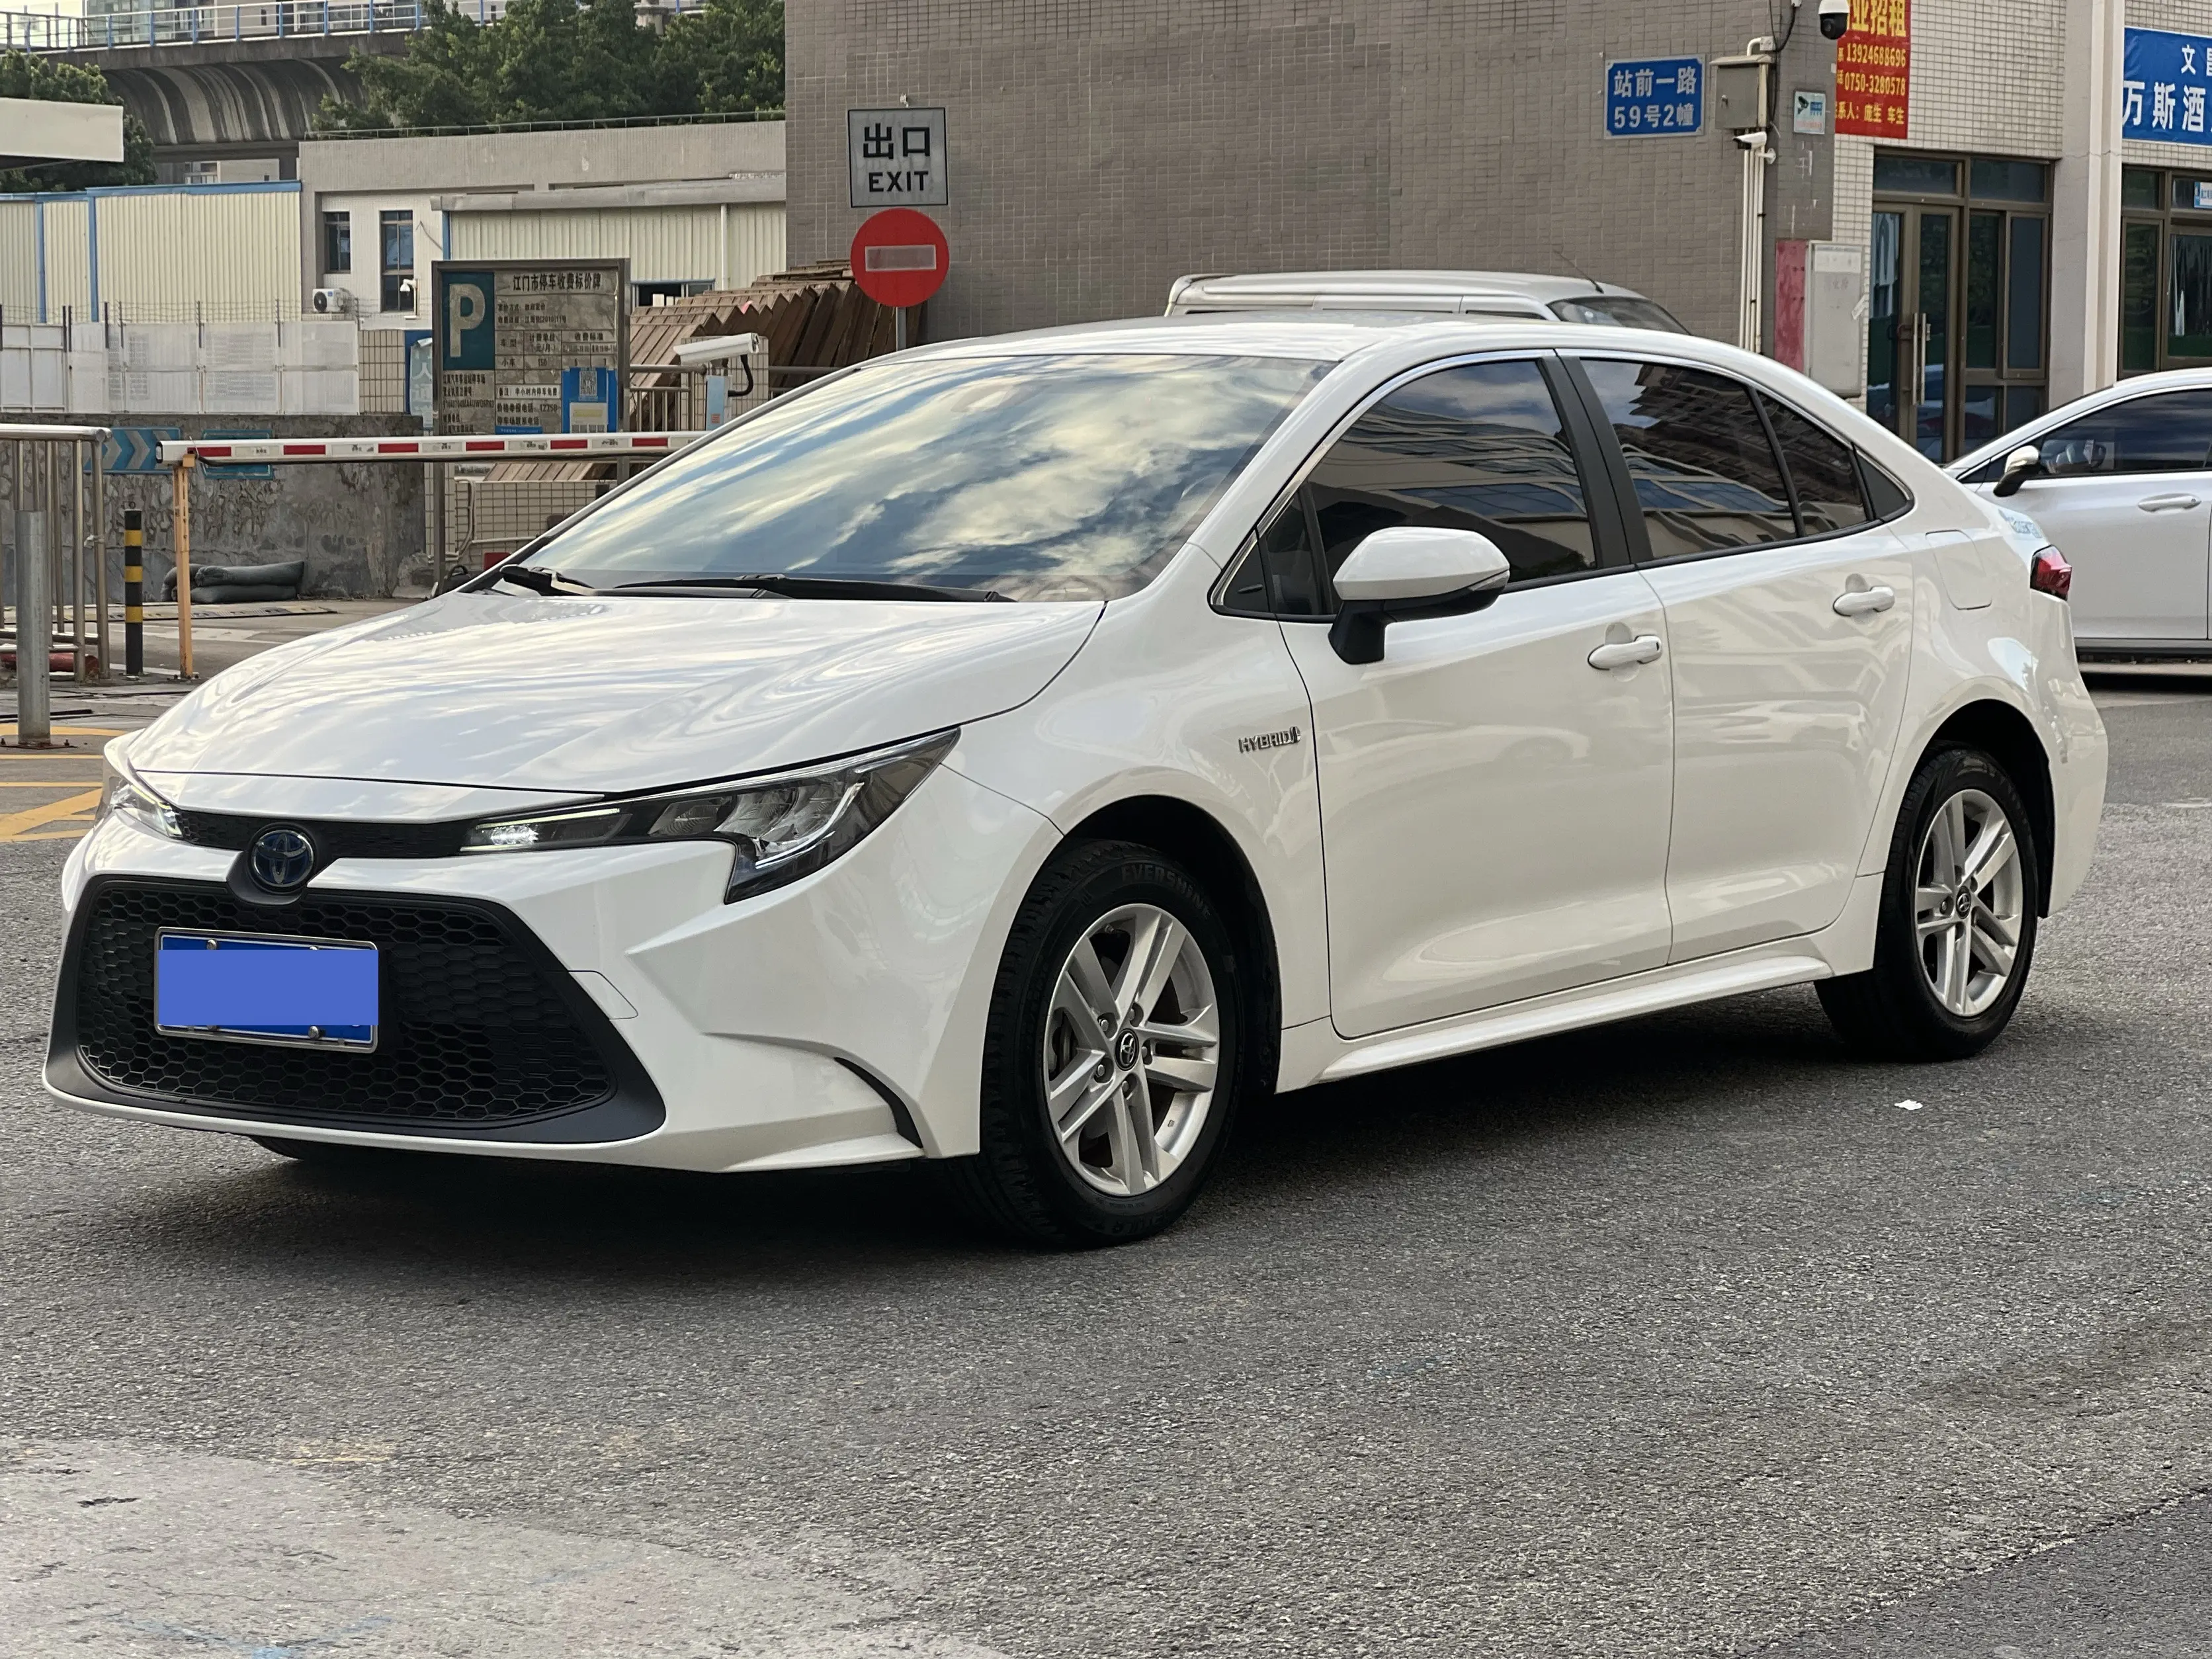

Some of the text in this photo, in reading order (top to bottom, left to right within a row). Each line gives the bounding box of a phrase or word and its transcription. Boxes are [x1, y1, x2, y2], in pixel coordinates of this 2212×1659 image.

[1848, 0, 1906, 37] 业招租
[1846, 42, 1906, 67] 13924688696
[1613, 66, 1697, 98] 站前一路
[1844, 72, 1906, 96] 0750-3280578
[1614, 103, 1694, 128] 59号2幢
[1835, 101, 1859, 120] 系人：
[2122, 80, 2212, 132] 万斯酒
[863, 123, 930, 159] 出口
[869, 171, 929, 192] EXIT
[513, 272, 601, 292] 江门市停车收费标价牌
[450, 283, 486, 358] P
[1238, 728, 1292, 753] HYBRID
